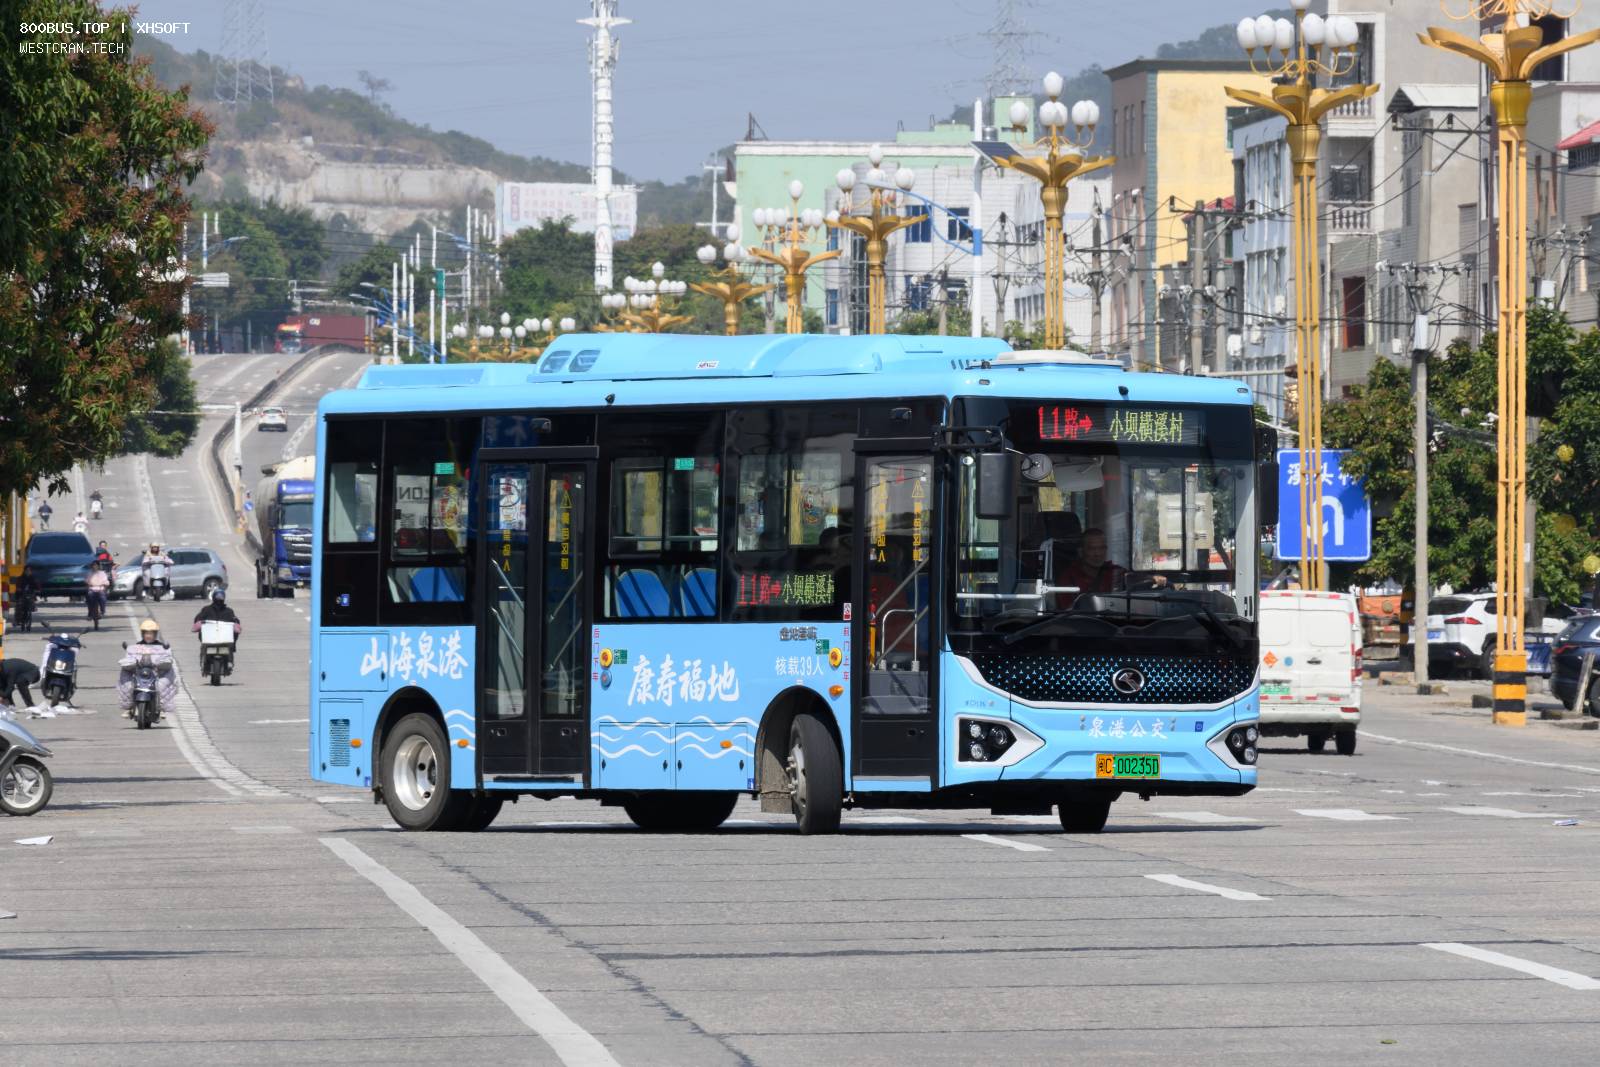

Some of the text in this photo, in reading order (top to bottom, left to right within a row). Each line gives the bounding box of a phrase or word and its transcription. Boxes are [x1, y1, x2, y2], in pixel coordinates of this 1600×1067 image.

[1110, 410, 1184, 443] 小坝横溪村
[360, 629, 470, 681] 山海泉港
[775, 655, 824, 676] 核载39人
[627, 654, 740, 707] 康寿福地
[1088, 716, 1168, 740] 泉港公交
